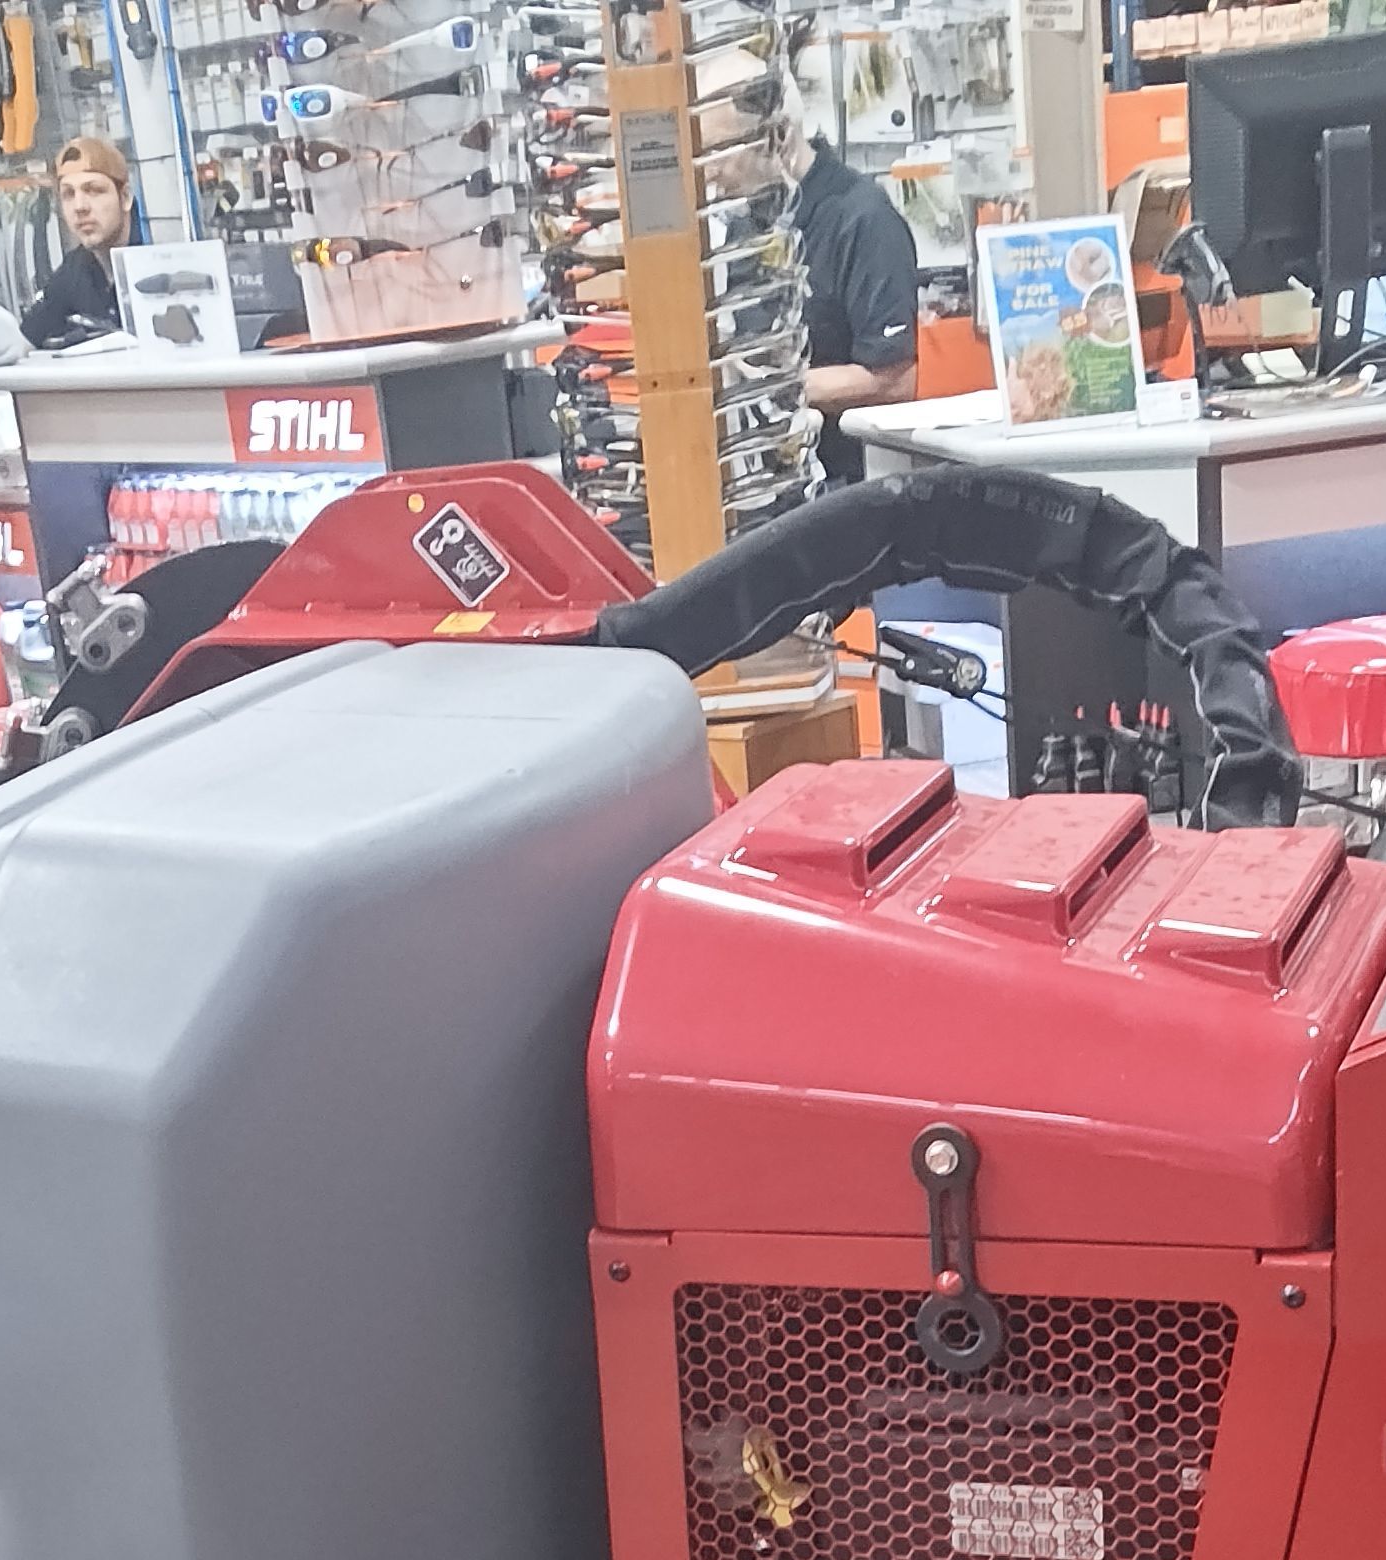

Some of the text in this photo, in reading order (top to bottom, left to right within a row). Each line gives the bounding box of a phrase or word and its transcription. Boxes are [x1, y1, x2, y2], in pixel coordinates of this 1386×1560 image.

[1017, 283, 1053, 296] FOR
[1013, 296, 1059, 310] SALE
[249, 399, 365, 452] STIHL
